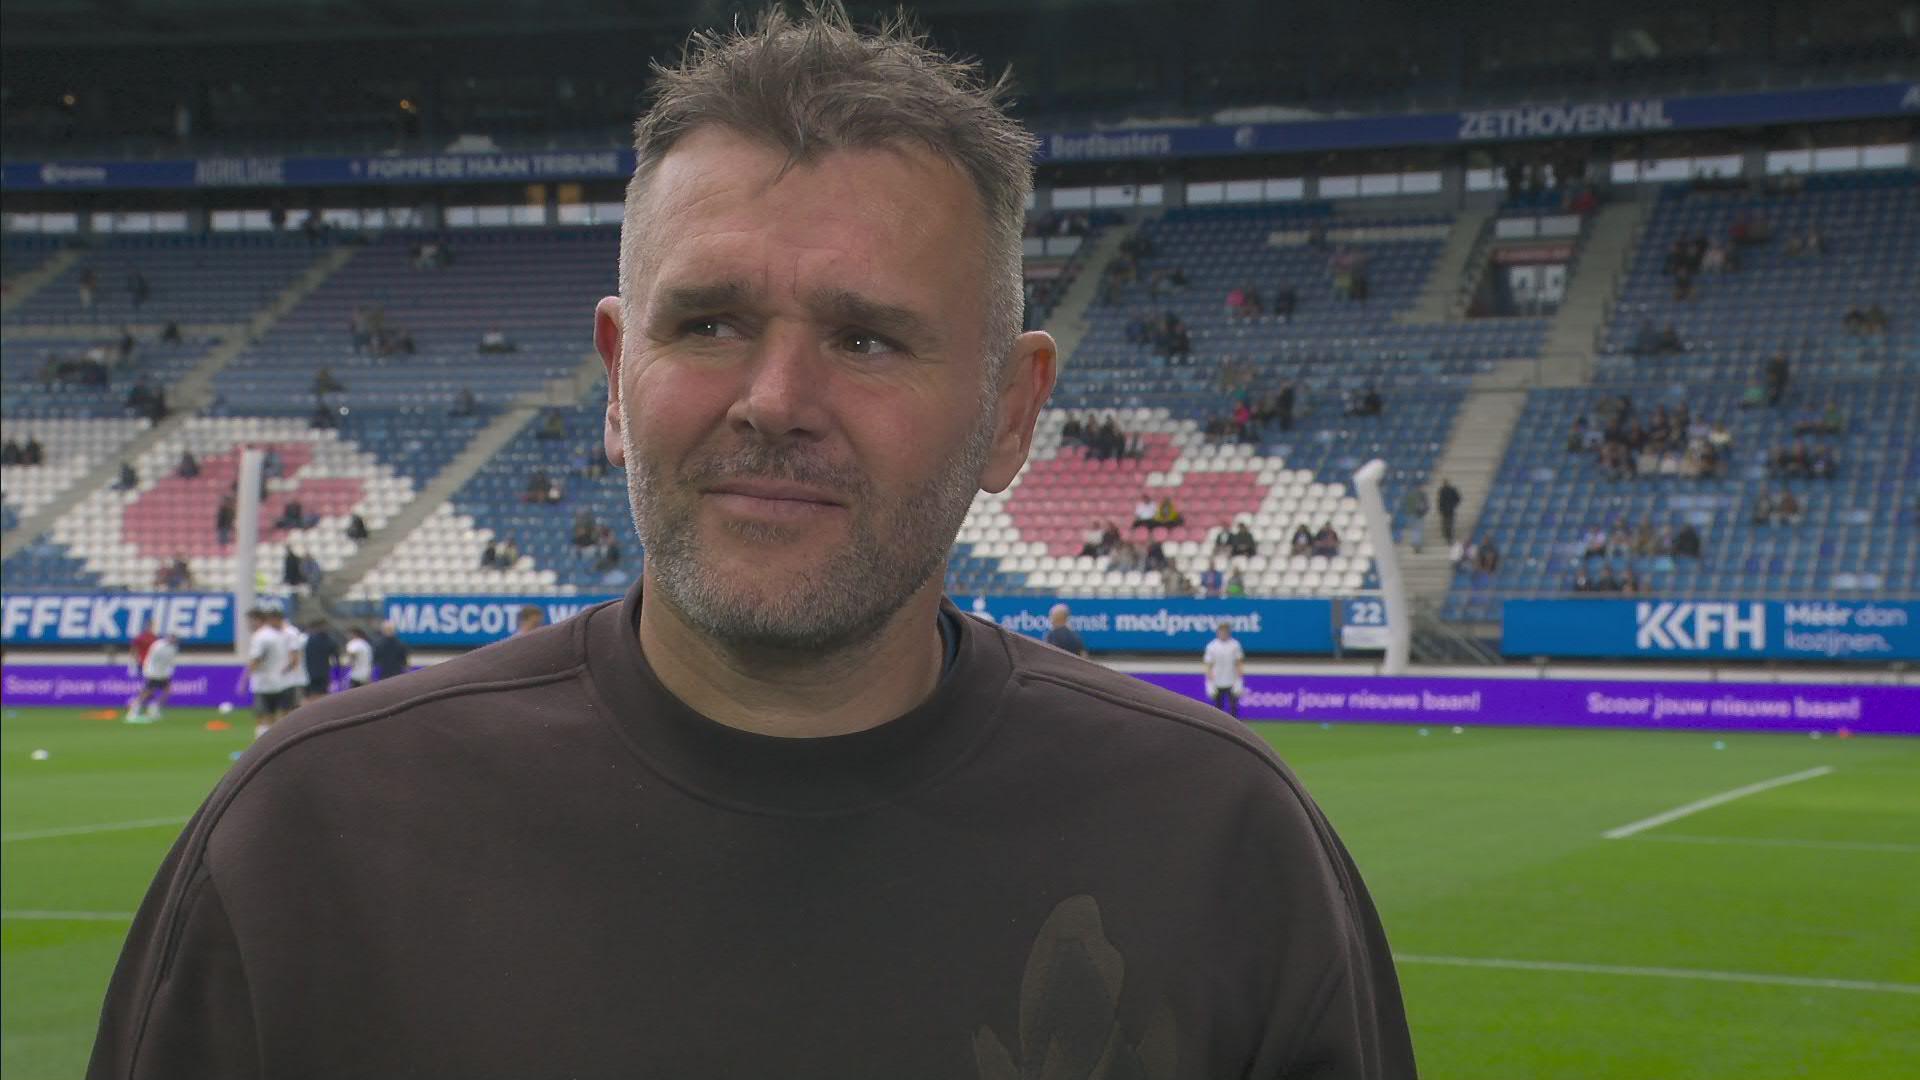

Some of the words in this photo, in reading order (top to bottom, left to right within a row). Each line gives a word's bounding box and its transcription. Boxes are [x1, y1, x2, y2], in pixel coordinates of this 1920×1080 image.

[1459, 100, 1673, 139] ZETHOVEN.NL
[435, 157, 463, 177] DE
[466, 156, 529, 176] HAAN
[533, 153, 617, 175] TRIBUNE
[387, 603, 521, 635] MASCOT
[1115, 608, 1262, 636] medprevent
[1351, 602, 1382, 624] 22
[1636, 602, 1766, 650] KKFH
[1855, 604, 1908, 627] dan
[1784, 629, 1893, 656] kozijnen.
[5, 674, 52, 696] Scoor
[53, 676, 97, 699] jouw
[1239, 687, 1295, 708] Scoor
[1296, 687, 1346, 713] jouw
[1349, 688, 1420, 710] nieuwe
[1423, 689, 1481, 712] baan!
[1586, 692, 1650, 714] Scoor
[1652, 693, 1708, 720] jouw
[1711, 695, 1792, 719] nieuwe
[1794, 696, 1861, 720] baan!
